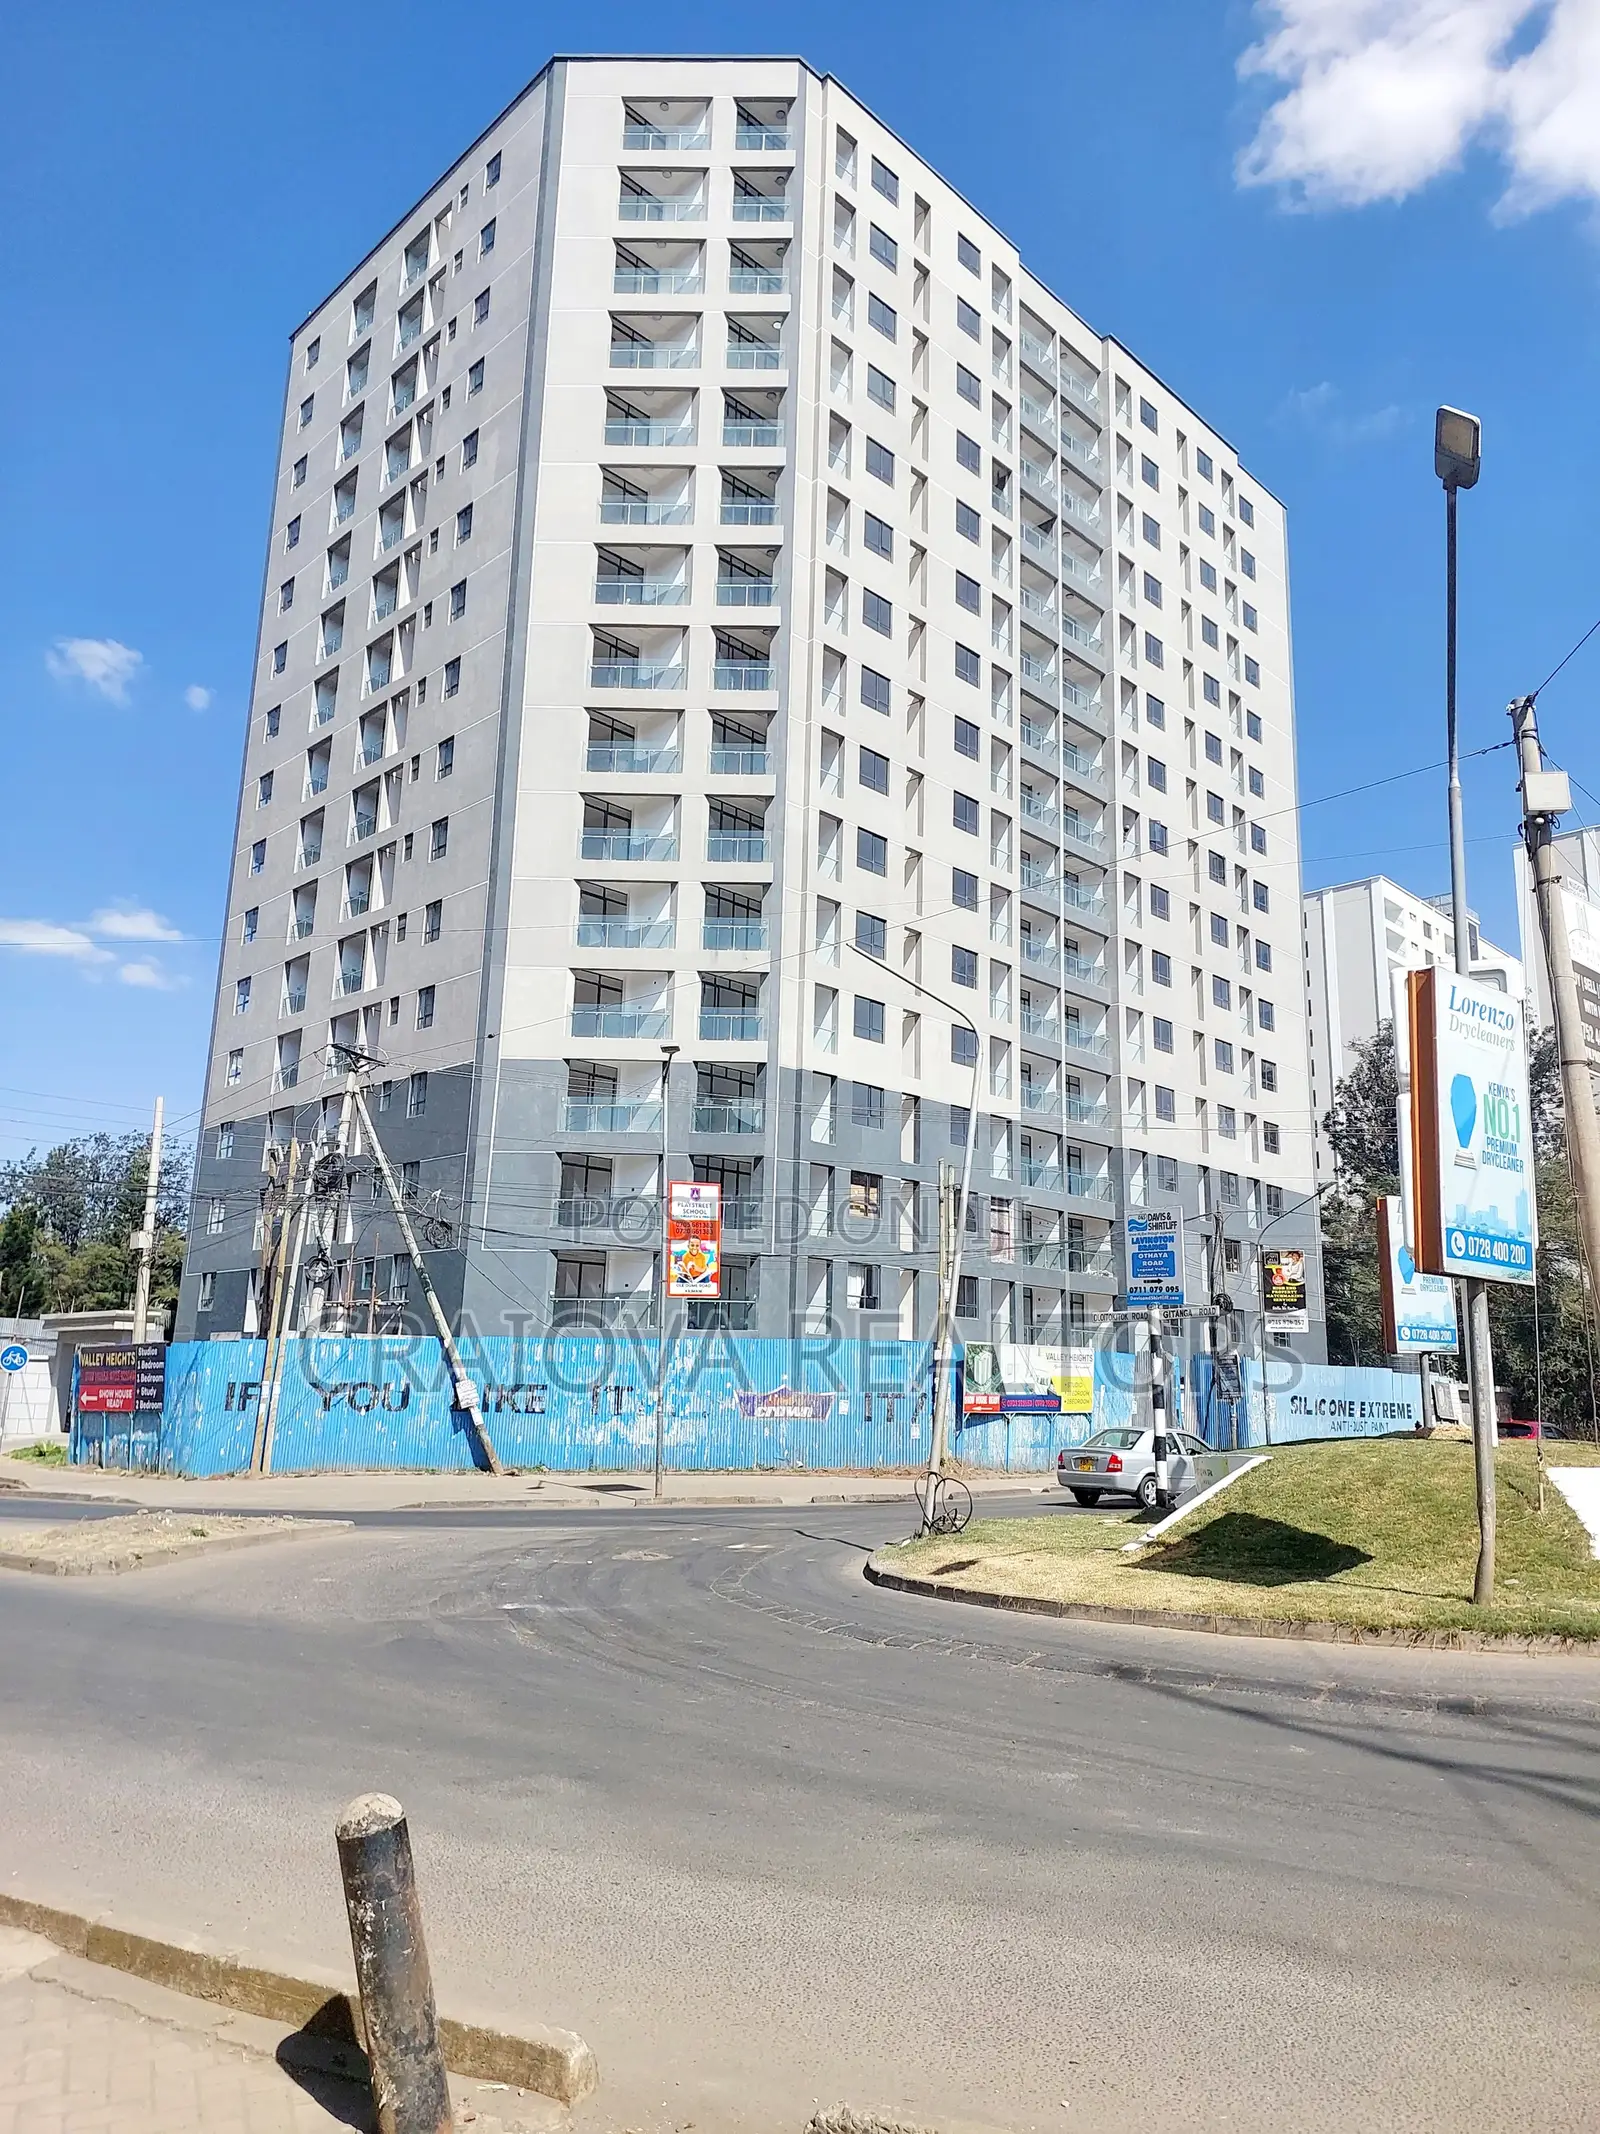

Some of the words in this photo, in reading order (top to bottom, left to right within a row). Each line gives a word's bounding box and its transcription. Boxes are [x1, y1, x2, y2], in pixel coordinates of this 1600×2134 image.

[1449, 984, 1514, 1031] Lorenzo
[1449, 1013, 1515, 1052] Drycleaners
[1488, 1081, 1516, 1102] KENYA'S
[1483, 1094, 1520, 1143] NO.1
[1486, 1136, 1518, 1157] PREMIUM
[1482, 1150, 1524, 1173] DRYCLEANER
[1148, 1213, 1166, 1221] DAVIS
[1166, 1212, 1171, 1220] &
[1148, 1221, 1177, 1231] SHIRTLIFF
[1131, 1235, 1174, 1245] LAVINGTON
[1467, 1236, 1491, 1259] 0728
[1492, 1240, 1509, 1262] 400
[1510, 1244, 1526, 1265] 200
[1129, 1286, 1146, 1294] 0711
[1131, 1311, 1149, 1320] ROAD
[1162, 1308, 1193, 1319] GITANGA
[1199, 1307, 1216, 1317] ROAD
[1411, 1329, 1427, 1340] 0728
[138, 1347, 158, 1356] Studios
[1046, 1353, 1068, 1361] VALLEY
[1069, 1354, 1094, 1362] HEIGHTS
[81, 1352, 105, 1367] VALLEY
[106, 1351, 136, 1366] HEIGHTS
[141, 1360, 164, 1369] Bedroom
[141, 1373, 164, 1383] Bedroom
[141, 1386, 157, 1399] Study
[224, 1382, 261, 1411] IF
[310, 1382, 411, 1413] YOU
[139, 1399, 163, 1409] Bedroom
[1290, 1395, 1355, 1418] SILICONE
[1359, 1401, 1412, 1420] EXTREME
